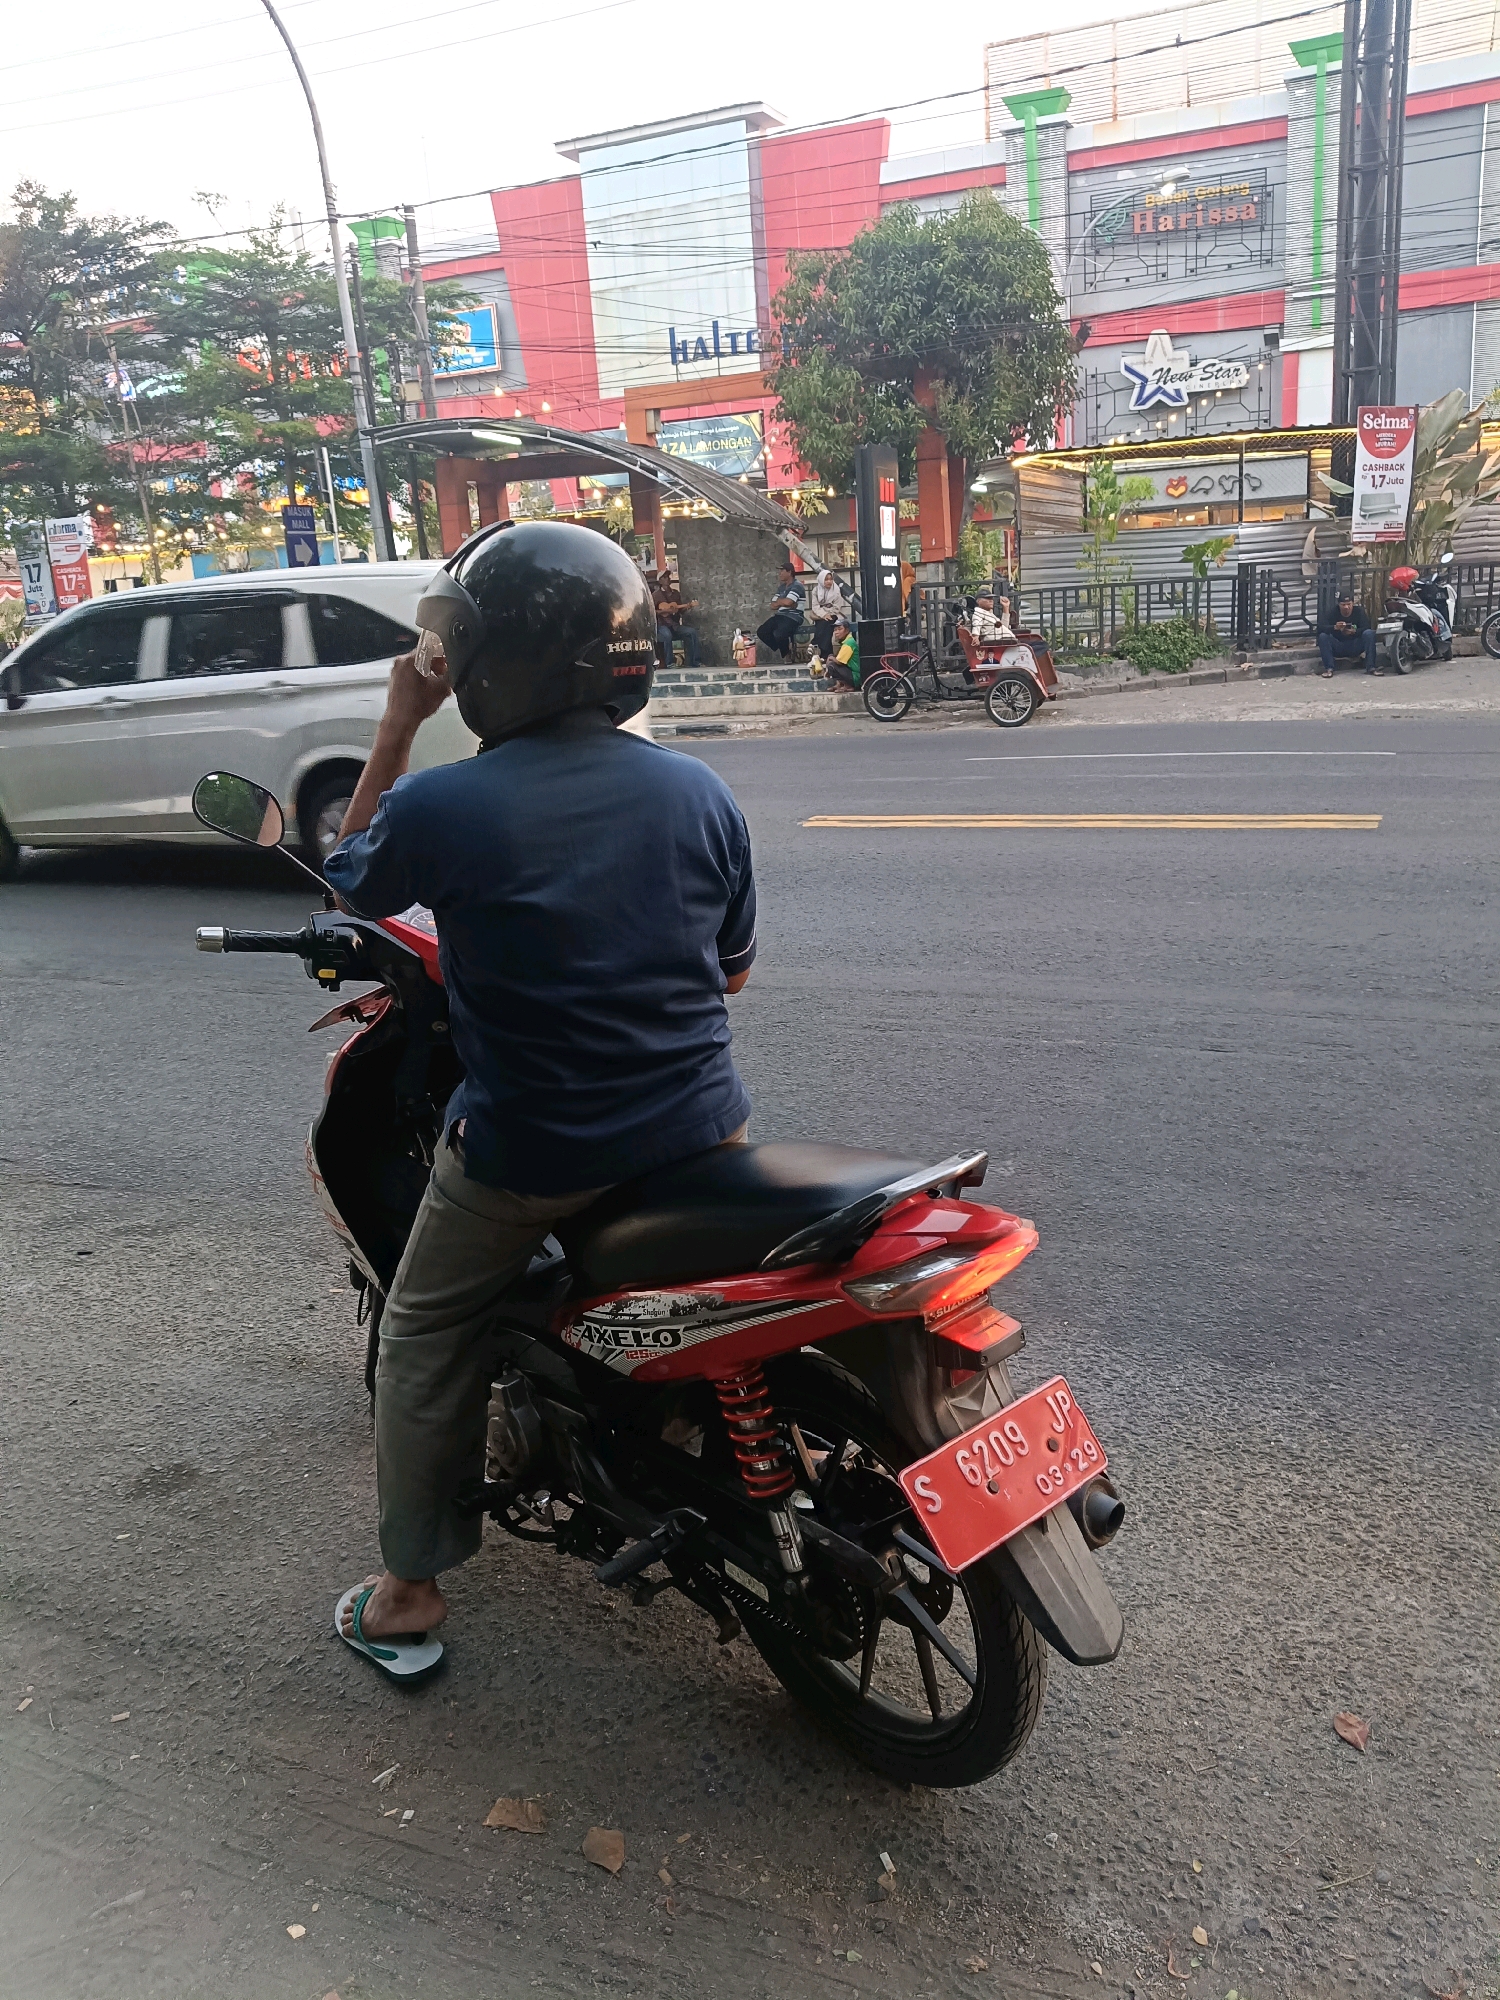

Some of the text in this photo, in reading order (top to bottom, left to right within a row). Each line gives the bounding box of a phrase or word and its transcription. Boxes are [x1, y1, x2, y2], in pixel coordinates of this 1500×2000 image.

[1194, 182, 1250, 199] Goreng
[1130, 203, 1257, 234] Harissa
[669, 320, 762, 365] HALTE
[1152, 362, 1242, 385] New Star
[1362, 413, 1409, 430] Selma
[689, 436, 752, 454] LAMONGAN
[1362, 463, 1405, 472] CASHBACK
[1371, 474, 1387, 490] 1,7
[1386, 477, 1405, 485] Juta
[287, 506, 312, 517] MASUK
[48, 523, 77, 536] informa
[291, 519, 310, 530] MALL
[24, 562, 43, 583] 1,7
[642, 1309, 667, 1317] Shogun
[580, 1321, 683, 1349] AXELO
[914, 1389, 1073, 1513] S 6209 JP
